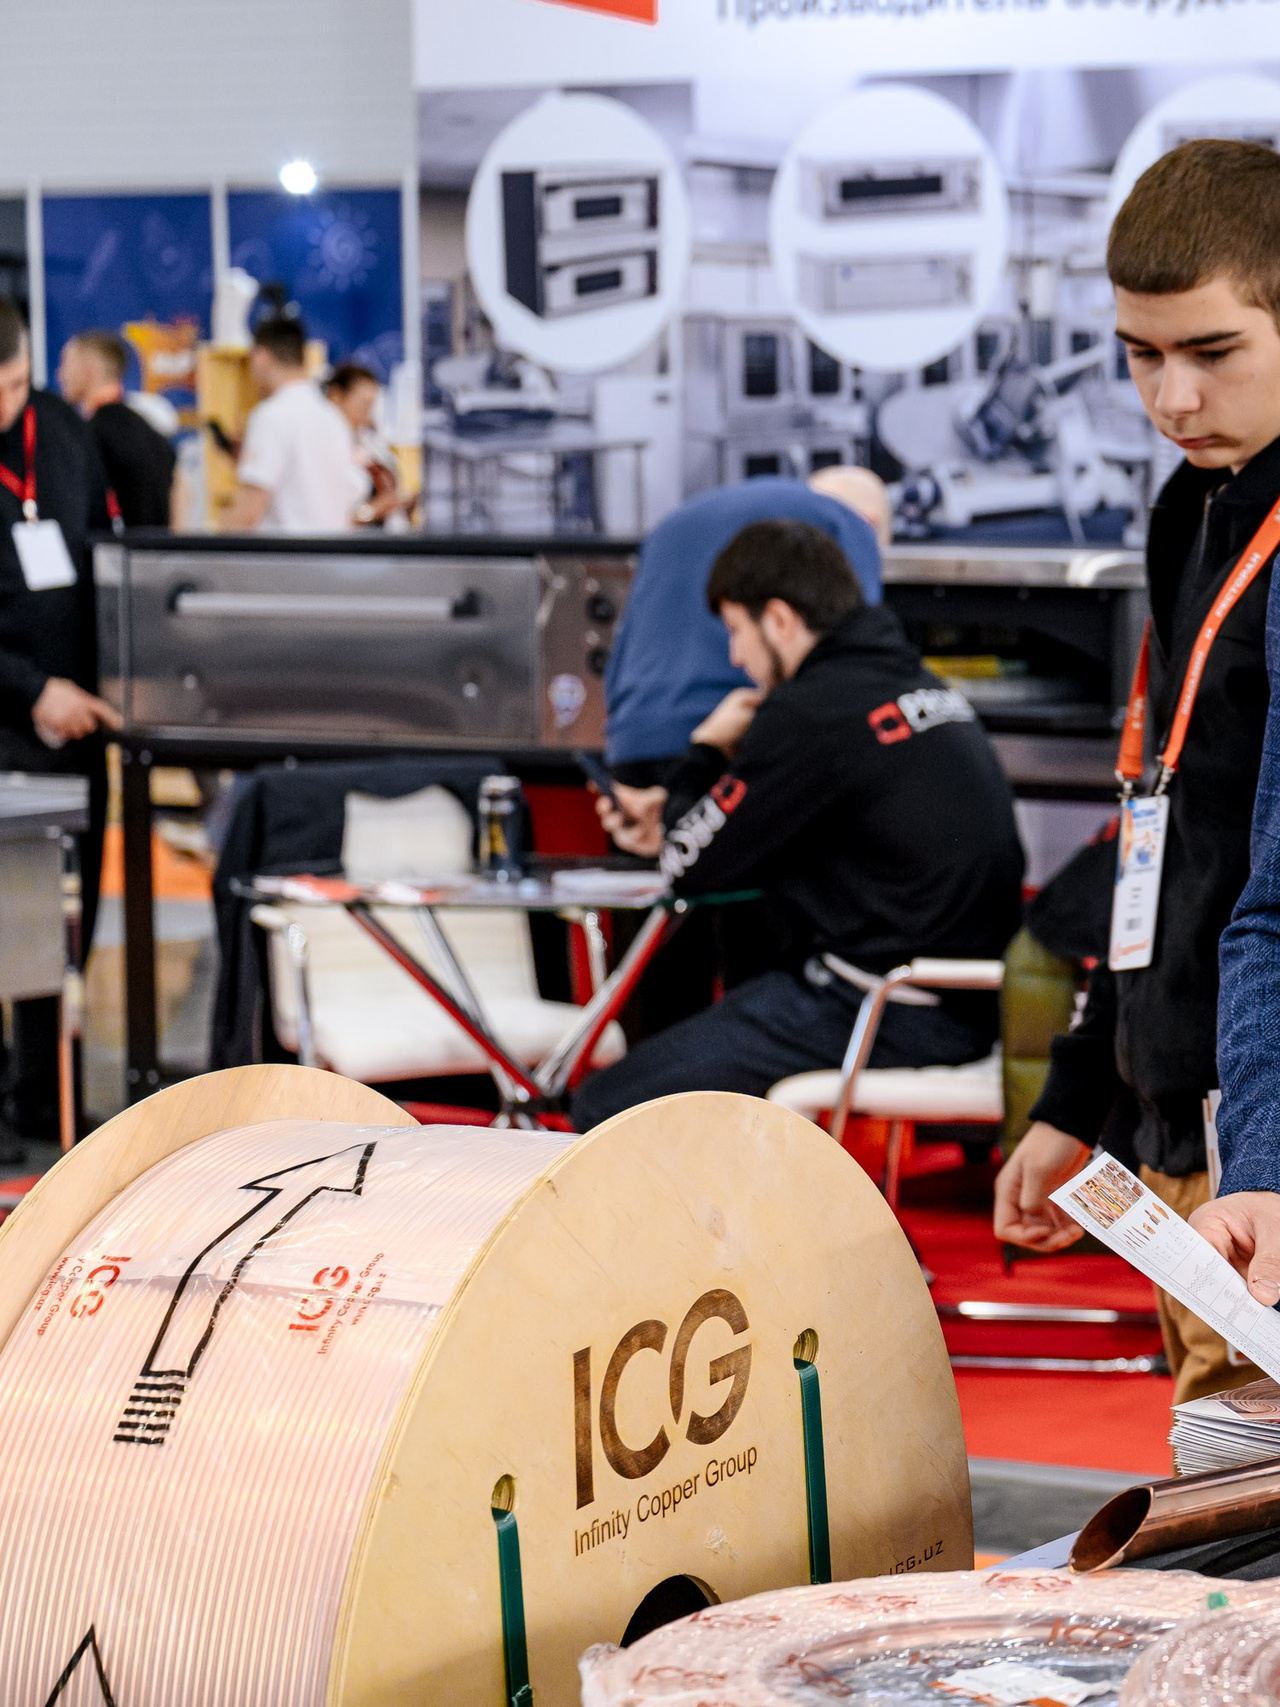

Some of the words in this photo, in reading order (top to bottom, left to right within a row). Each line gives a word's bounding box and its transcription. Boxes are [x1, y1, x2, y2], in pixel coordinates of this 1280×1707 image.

[70, 1254, 132, 1319] ICG
[288, 1265, 350, 1332] ICG
[573, 1288, 753, 1510] ICG
[574, 1507, 631, 1557] Infinity
[637, 1472, 701, 1523] Copper
[705, 1445, 758, 1487] Group
